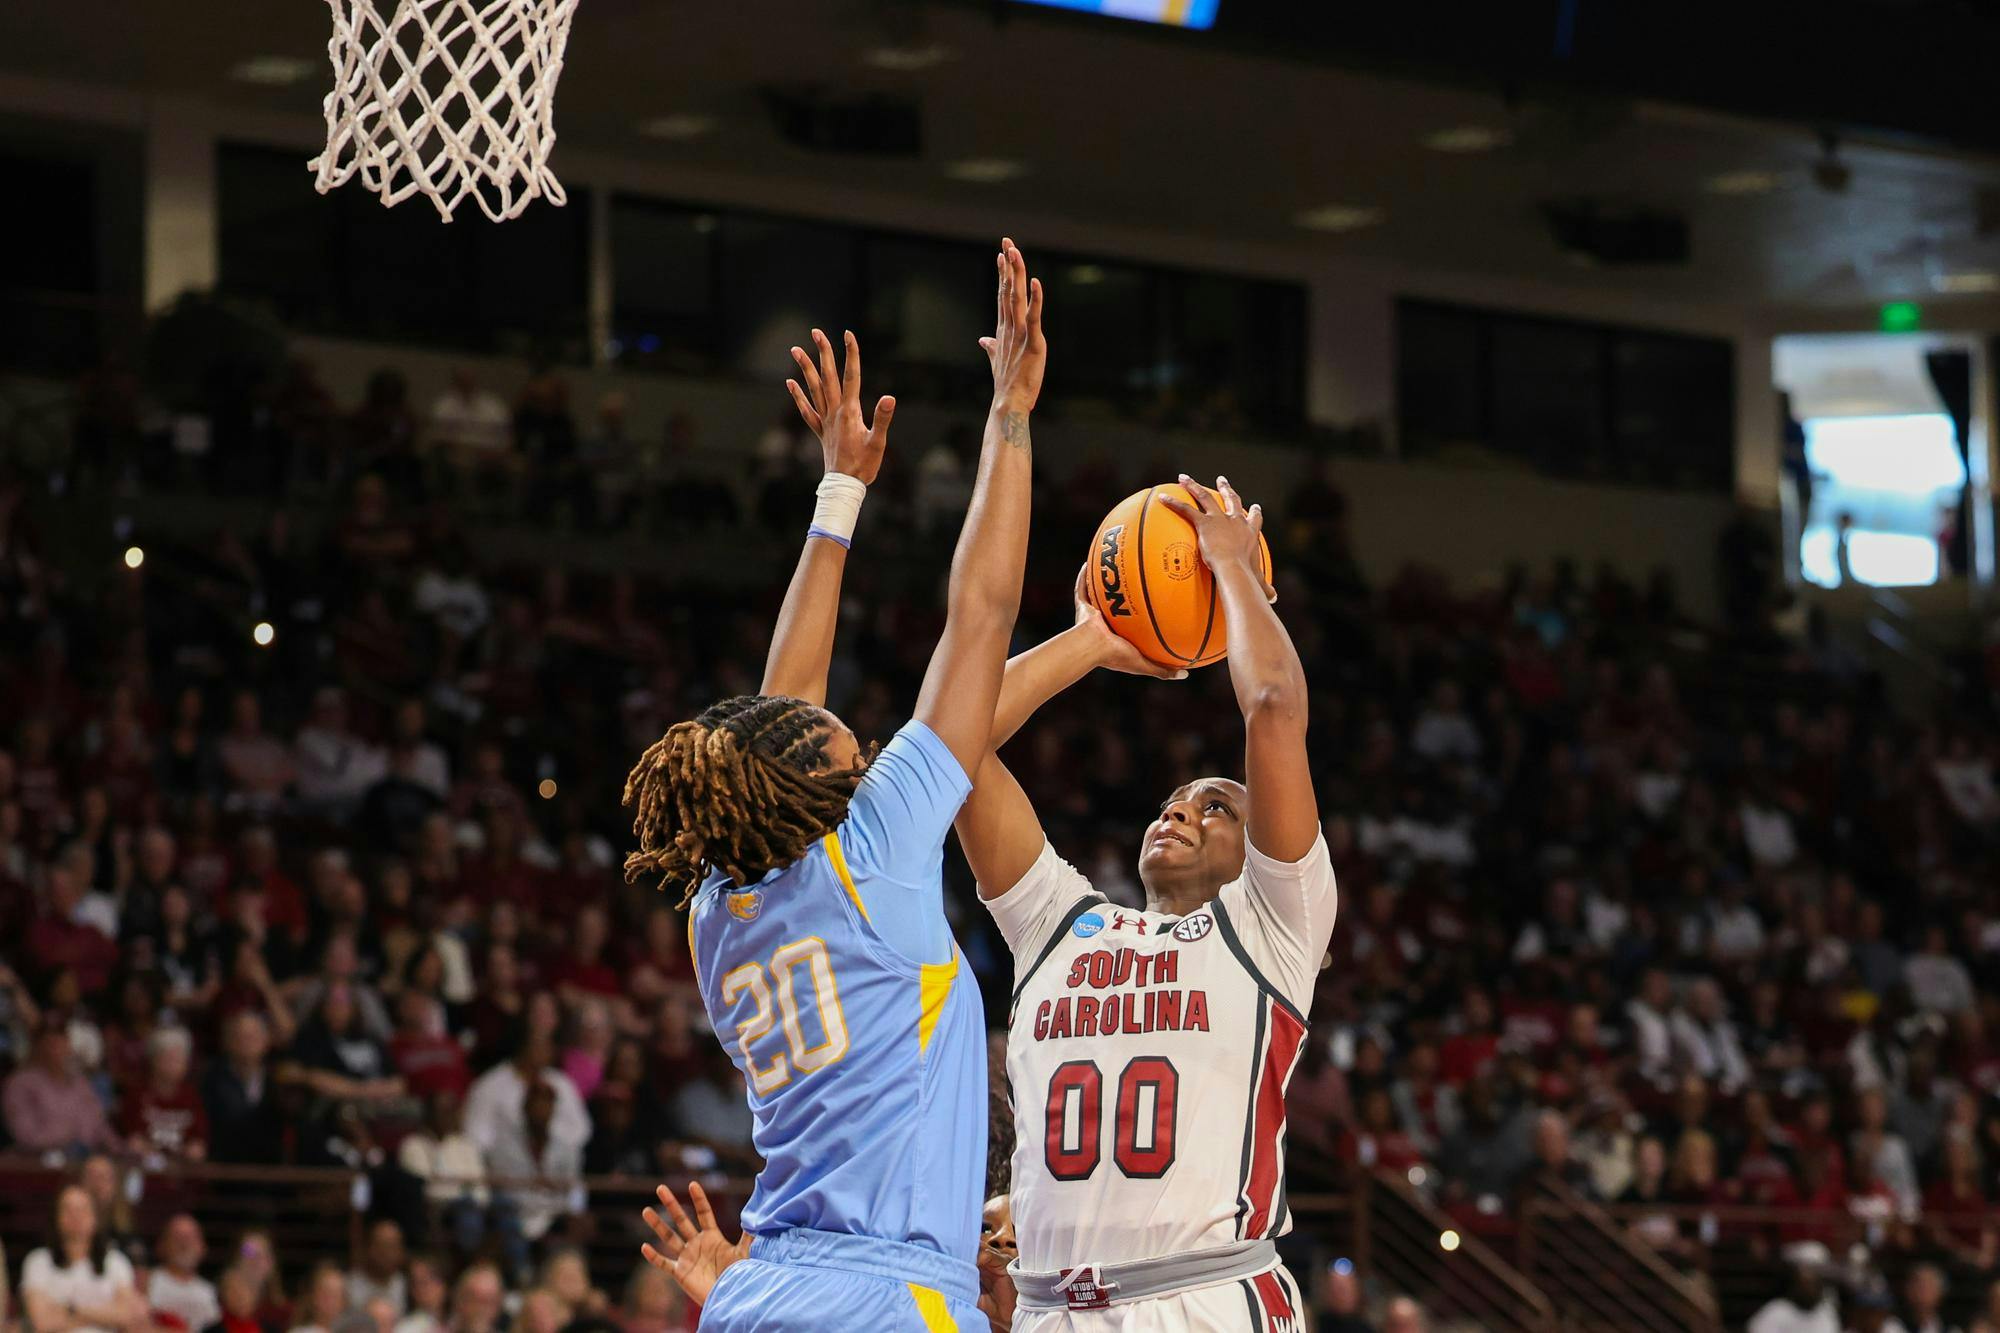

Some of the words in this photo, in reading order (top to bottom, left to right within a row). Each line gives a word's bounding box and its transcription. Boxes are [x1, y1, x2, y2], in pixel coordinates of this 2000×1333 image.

[1100, 524, 1132, 618] NCAA
[1175, 915, 1211, 940] SEC
[1066, 948, 1179, 989] SOUTH
[722, 935, 849, 1098] 20
[1034, 990, 1210, 1042] CAROLINA
[1044, 1056, 1179, 1181] 00
[1074, 1291, 1097, 1301] SOUTH
